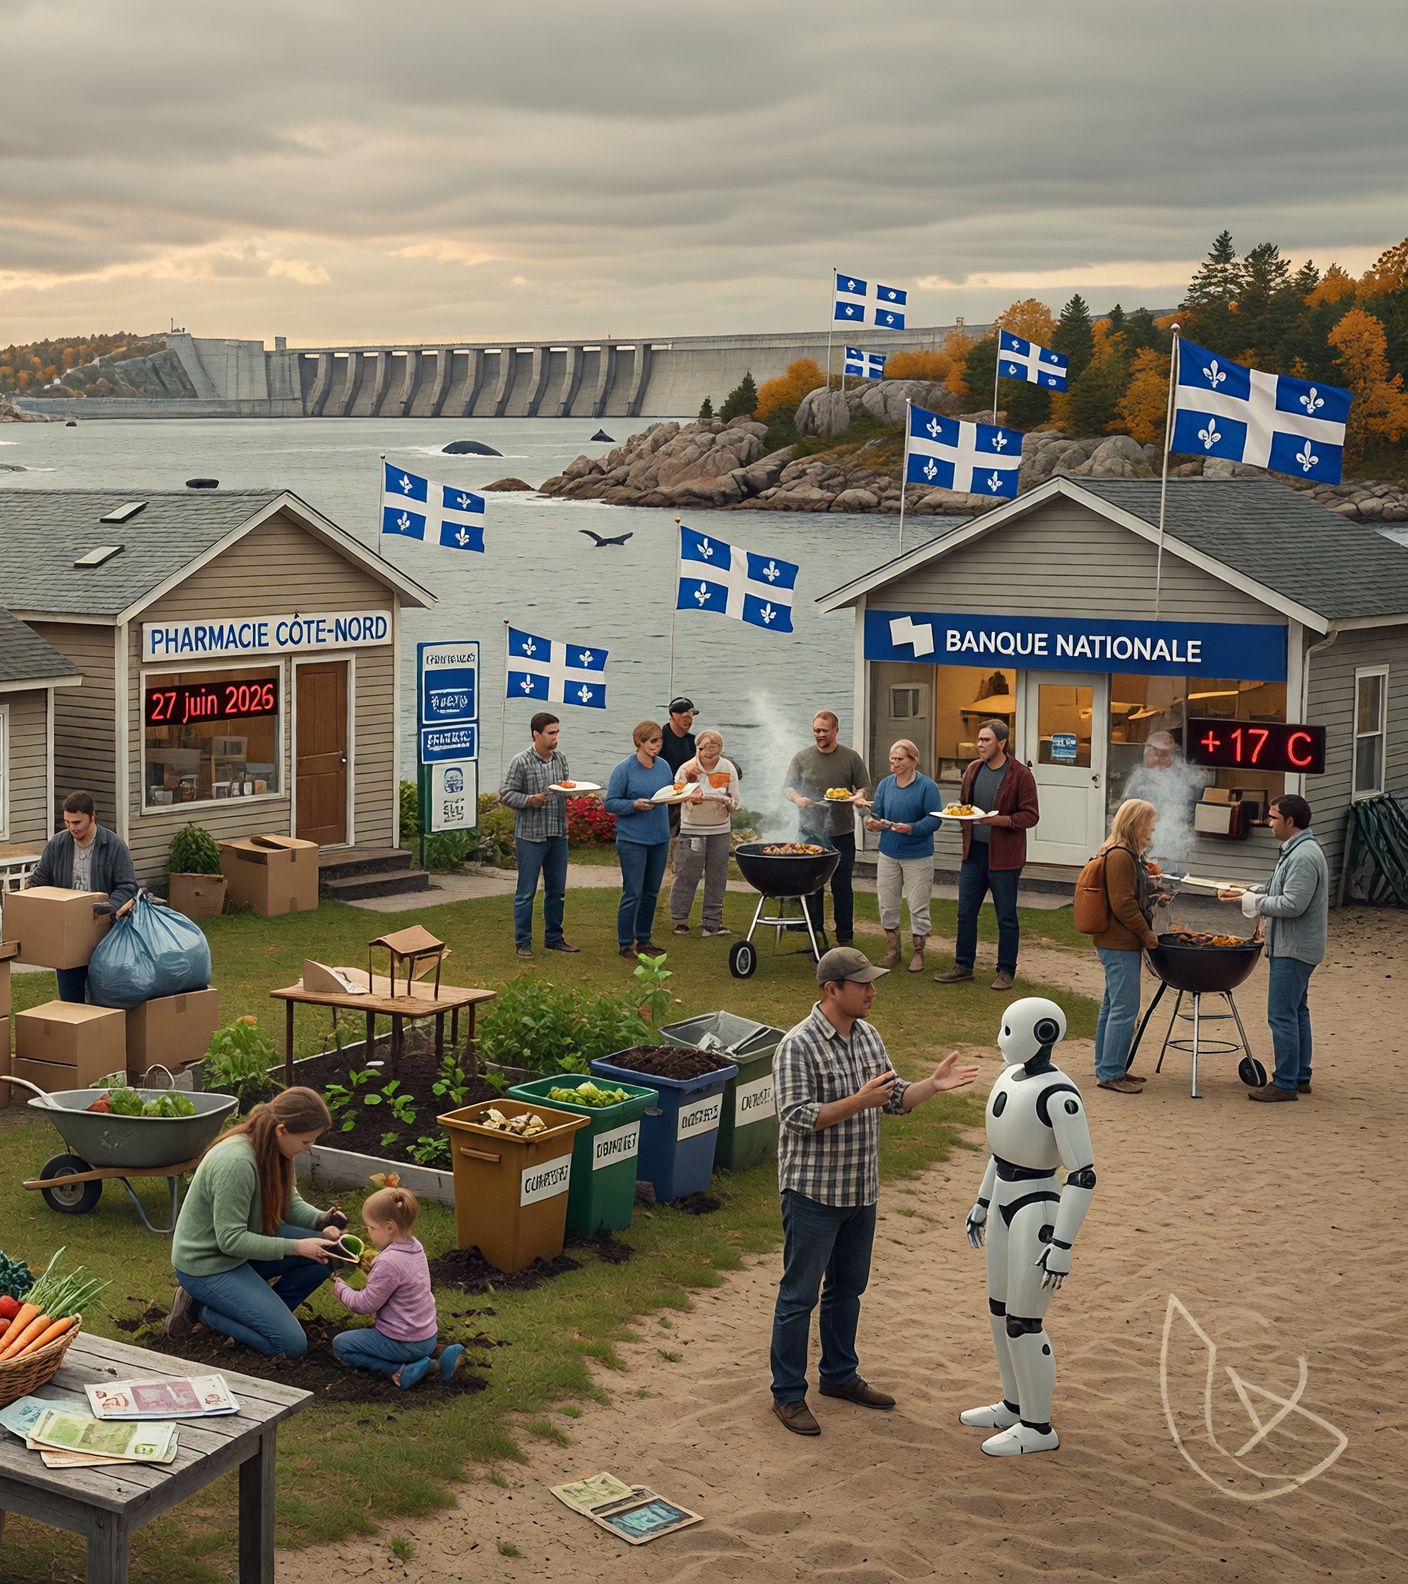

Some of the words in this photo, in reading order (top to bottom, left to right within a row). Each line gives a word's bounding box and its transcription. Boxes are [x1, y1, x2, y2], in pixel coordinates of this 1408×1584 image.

[151, 622, 269, 654] PHARMACIE
[275, 612, 388, 646] CÔTE-NORD
[945, 629, 1049, 656] BANQUE
[1055, 634, 1202, 664] NATIONALE
[151, 692, 177, 720] 27
[182, 688, 218, 724] juin
[225, 683, 274, 714] 2026
[1286, 731, 1313, 766] C
